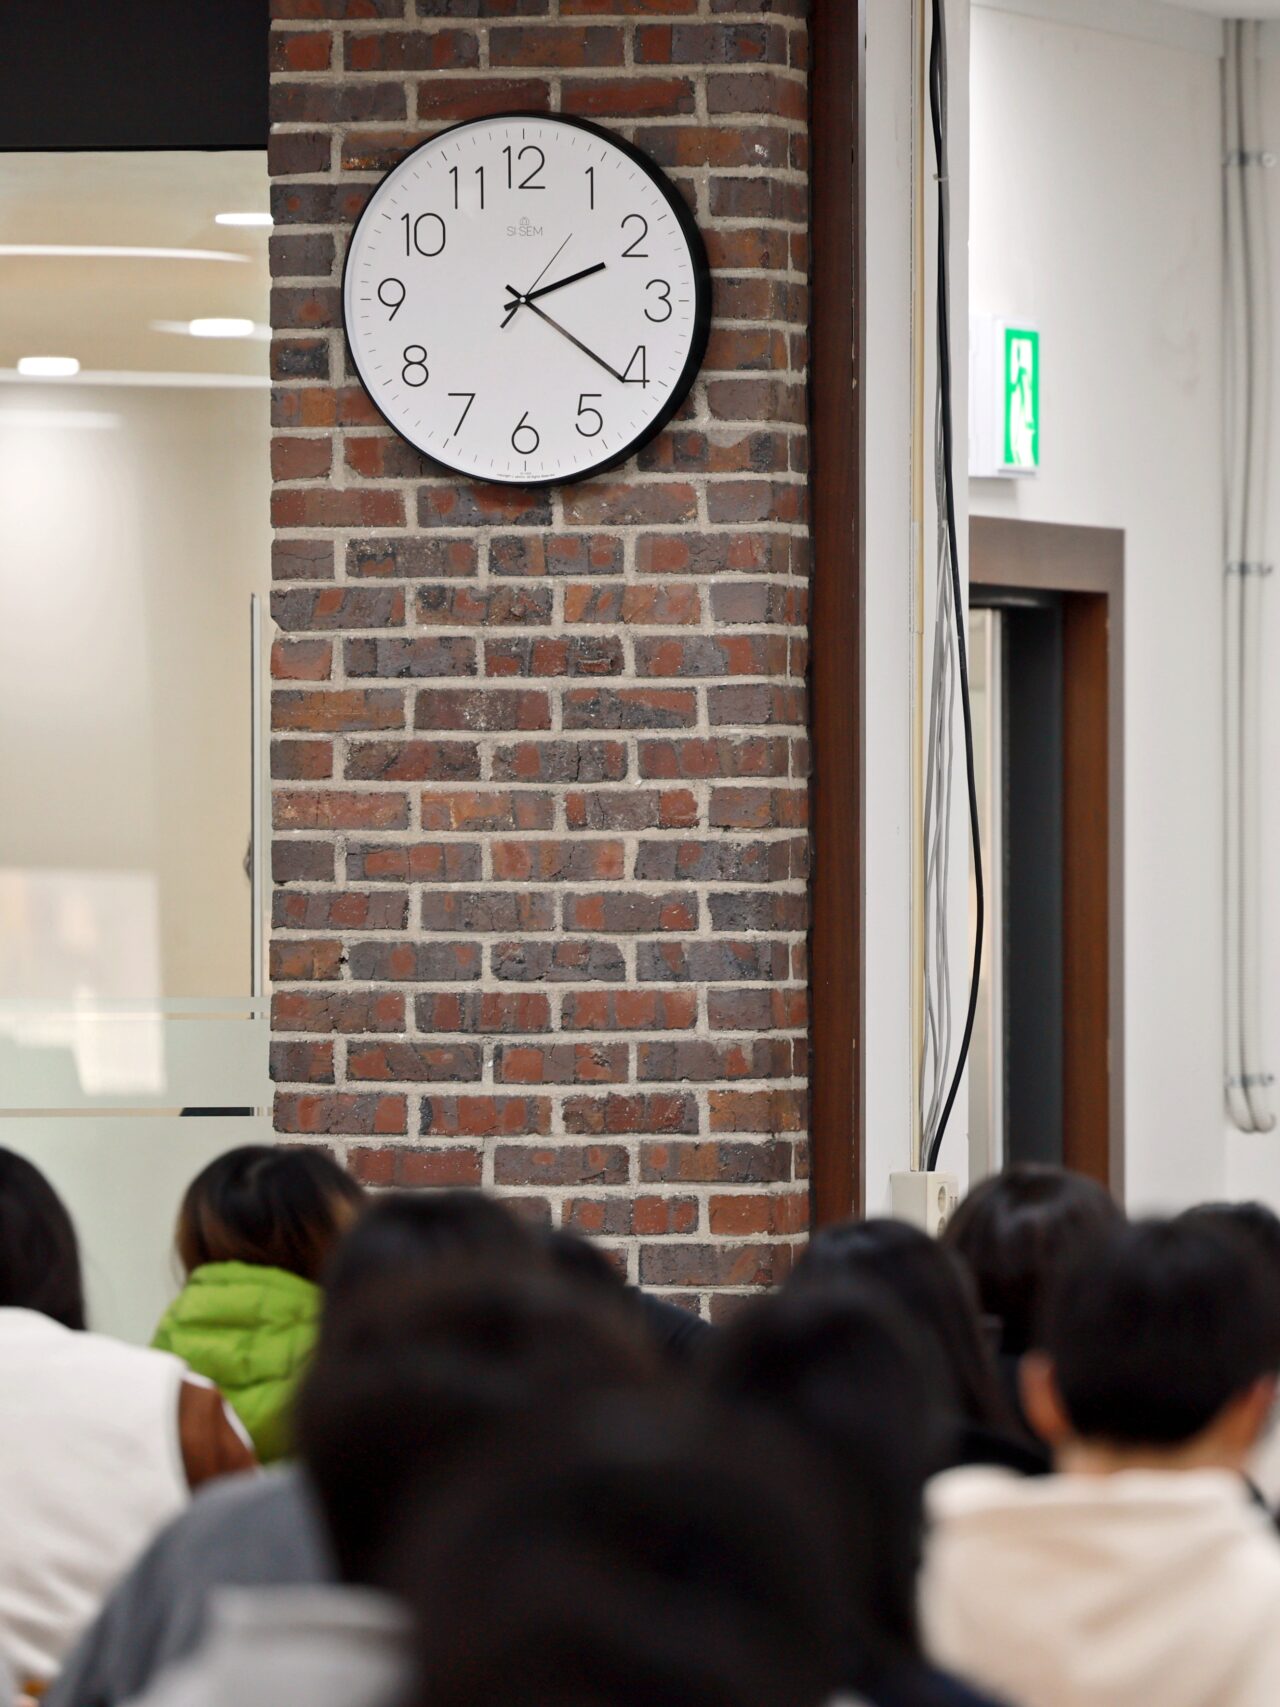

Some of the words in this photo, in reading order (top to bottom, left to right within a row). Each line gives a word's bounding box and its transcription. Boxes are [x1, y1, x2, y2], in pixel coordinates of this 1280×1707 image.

[449, 166, 484, 209] 11
[502, 146, 546, 189] 12
[585, 166, 594, 210] 1
[401, 213, 446, 257] 10
[621, 214, 648, 257] 2
[378, 278, 406, 321] 9
[644, 279, 672, 323] 3
[402, 345, 429, 387] 8
[621, 345, 650, 389] 4
[447, 393, 476, 436] 7
[511, 411, 540, 454] 6
[575, 394, 603, 437] 5
